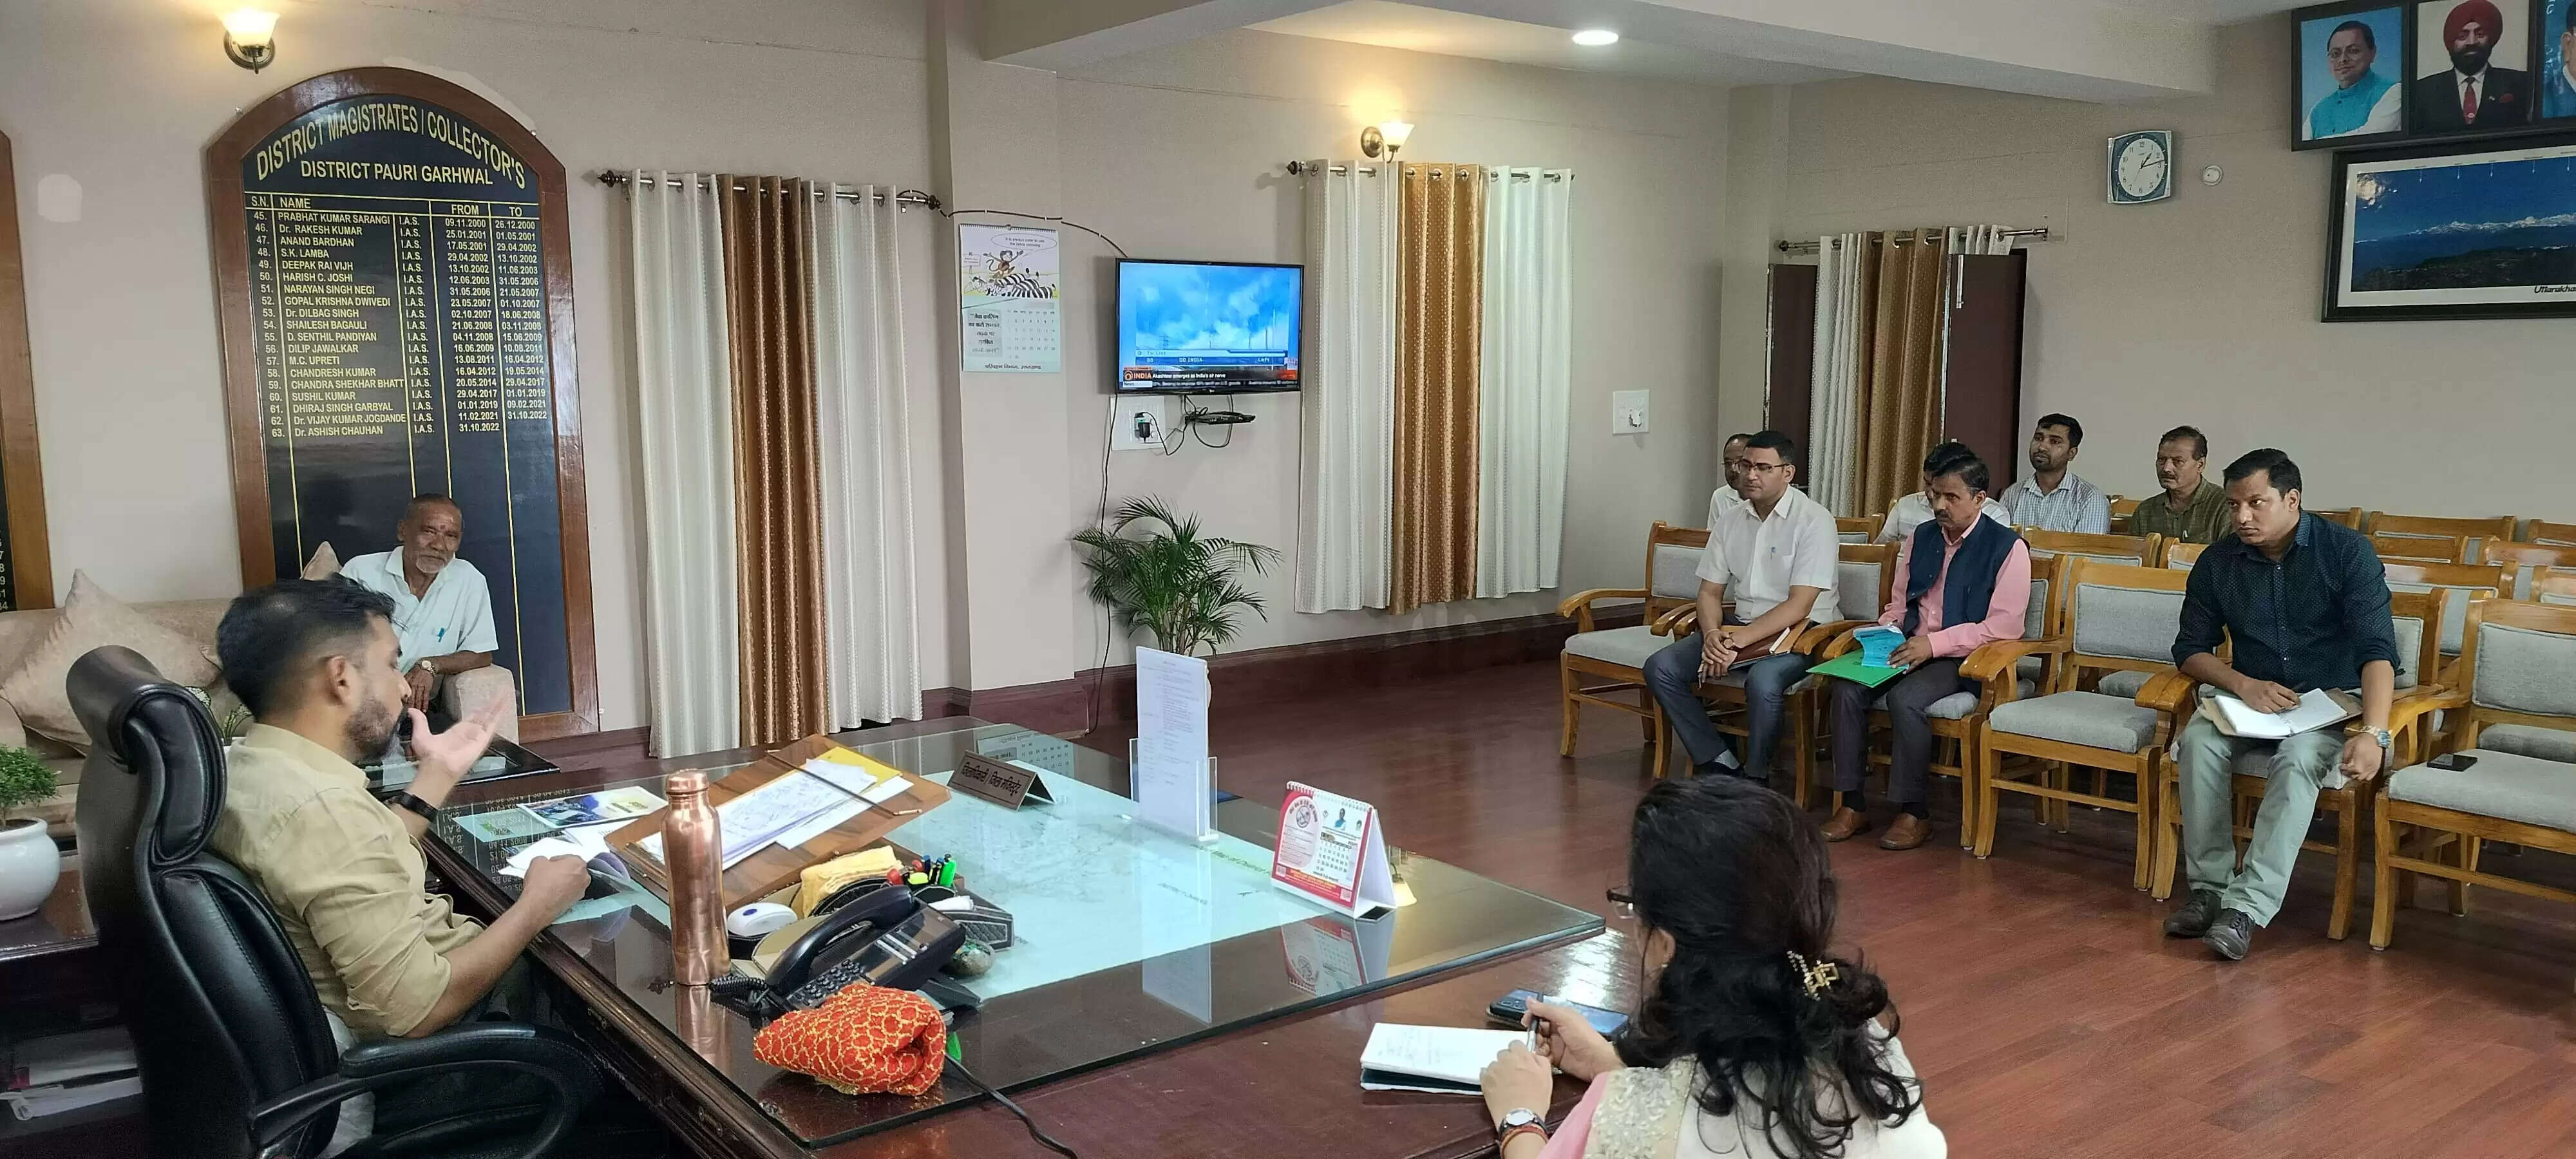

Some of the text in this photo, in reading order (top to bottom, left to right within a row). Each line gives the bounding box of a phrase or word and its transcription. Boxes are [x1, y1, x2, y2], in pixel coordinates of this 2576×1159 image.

[256, 104, 526, 189] DISTRICT MAGISTRATES COLLECTOR'S
[301, 160, 493, 186] DISTRICT PAURI GARHWAL
[252, 196, 522, 217] S.N. NAME FROM TO
[254, 212, 267, 220] 45.
[278, 212, 317, 221] PRABHAT
[321, 214, 350, 223] KUMAR
[353, 215, 390, 224] SARANGI
[446, 218, 486, 227] 09.11.2000
[495, 220, 535, 229] 26.12.2000
[279, 225, 290, 233] Dr.
[295, 225, 330, 234] RAKESH
[332, 227, 363, 235] KUMAR
[401, 229, 421, 237] I.A.S.
[446, 230, 486, 239] 25.01.2001
[497, 232, 535, 241] 01.05.2001
[256, 236, 536, 252] 47. ANAND BARDHAN I.A.S. 17.05.2001 29.04.2002
[258, 248, 537, 263] 48. S.K. LAMBA I.A.S. 29.04.2002 13.10.2002
[259, 260, 538, 274] 49. DEEPAK RAI VIJH I.A.S. 13.10.2002 11.06.2003
[260, 272, 272, 281] 50.
[283, 272, 315, 281] HARISH
[317, 274, 325, 282] C.
[327, 274, 353, 282] JOSHI
[404, 275, 424, 283] I.A.S.
[499, 277, 538, 285] 31.05.2006
[261, 285, 273, 293] 51.
[284, 285, 323, 294] NARAYAN
[326, 286, 352, 294] SINGH
[404, 287, 424, 295] I.A.S.
[450, 288, 490, 296] 31.05.2006
[500, 288, 539, 297] 21.05.2007
[262, 296, 540, 308] 52. GOPAL KRISHNA DWIVEDI I.A.S. 23.05.2007 01.10.2007
[263, 308, 540, 319] 53. Dr. DILBAG SINGH I.A.S. 02.10.2007 18.06.2008
[263, 321, 276, 329] 54.
[287, 321, 328, 330] SHAILESH
[332, 321, 366, 330] BAGAULI
[407, 321, 427, 330] I.A.S.
[265, 332, 542, 341] 55. D. SENTHIL PANDIYAN I.A.S. 04.11.2008 15.06.2009
[265, 344, 278, 353] 56.
[289, 344, 310, 353] DILIP
[312, 344, 358, 353] JAWALKAR
[408, 344, 428, 353] I.A.S.
[454, 344, 494, 352] 16.06.2009
[267, 357, 279, 365] 57.
[290, 357, 307, 365] M.C.
[309, 356, 340, 364] UPRETI
[267, 367, 544, 377] 58. CHANDRESH KUMAR I.A.S. 16.04.2012 19.05.2014
[269, 381, 281, 389] 59.
[292, 381, 334, 390] CHANDRA
[335, 379, 375, 388] SHEKHAR
[378, 379, 404, 388] BHATT
[457, 378, 497, 386] 20.05.2014
[270, 393, 282, 401] 60.
[292, 392, 323, 401] SUSHIL
[325, 391, 355, 400] KUMAR
[412, 390, 432, 399] I.A.S.
[457, 390, 497, 398] 29.04.2017
[270, 400, 546, 413] 61. DHIRAJ SINGH GARBYAL I.A.S. 01.01.2019 09.02.2021
[271, 411, 547, 425] 62. Dr. VIJAY KUMAR JOGDANDE I.A.S. 11.02.2021 31.10.2022
[272, 429, 285, 437] 63.
[295, 428, 306, 437] Dr.
[308, 428, 339, 437] ASHISH
[341, 426, 383, 435] CHAUHAN
[459, 423, 500, 431] 31.10.2022
